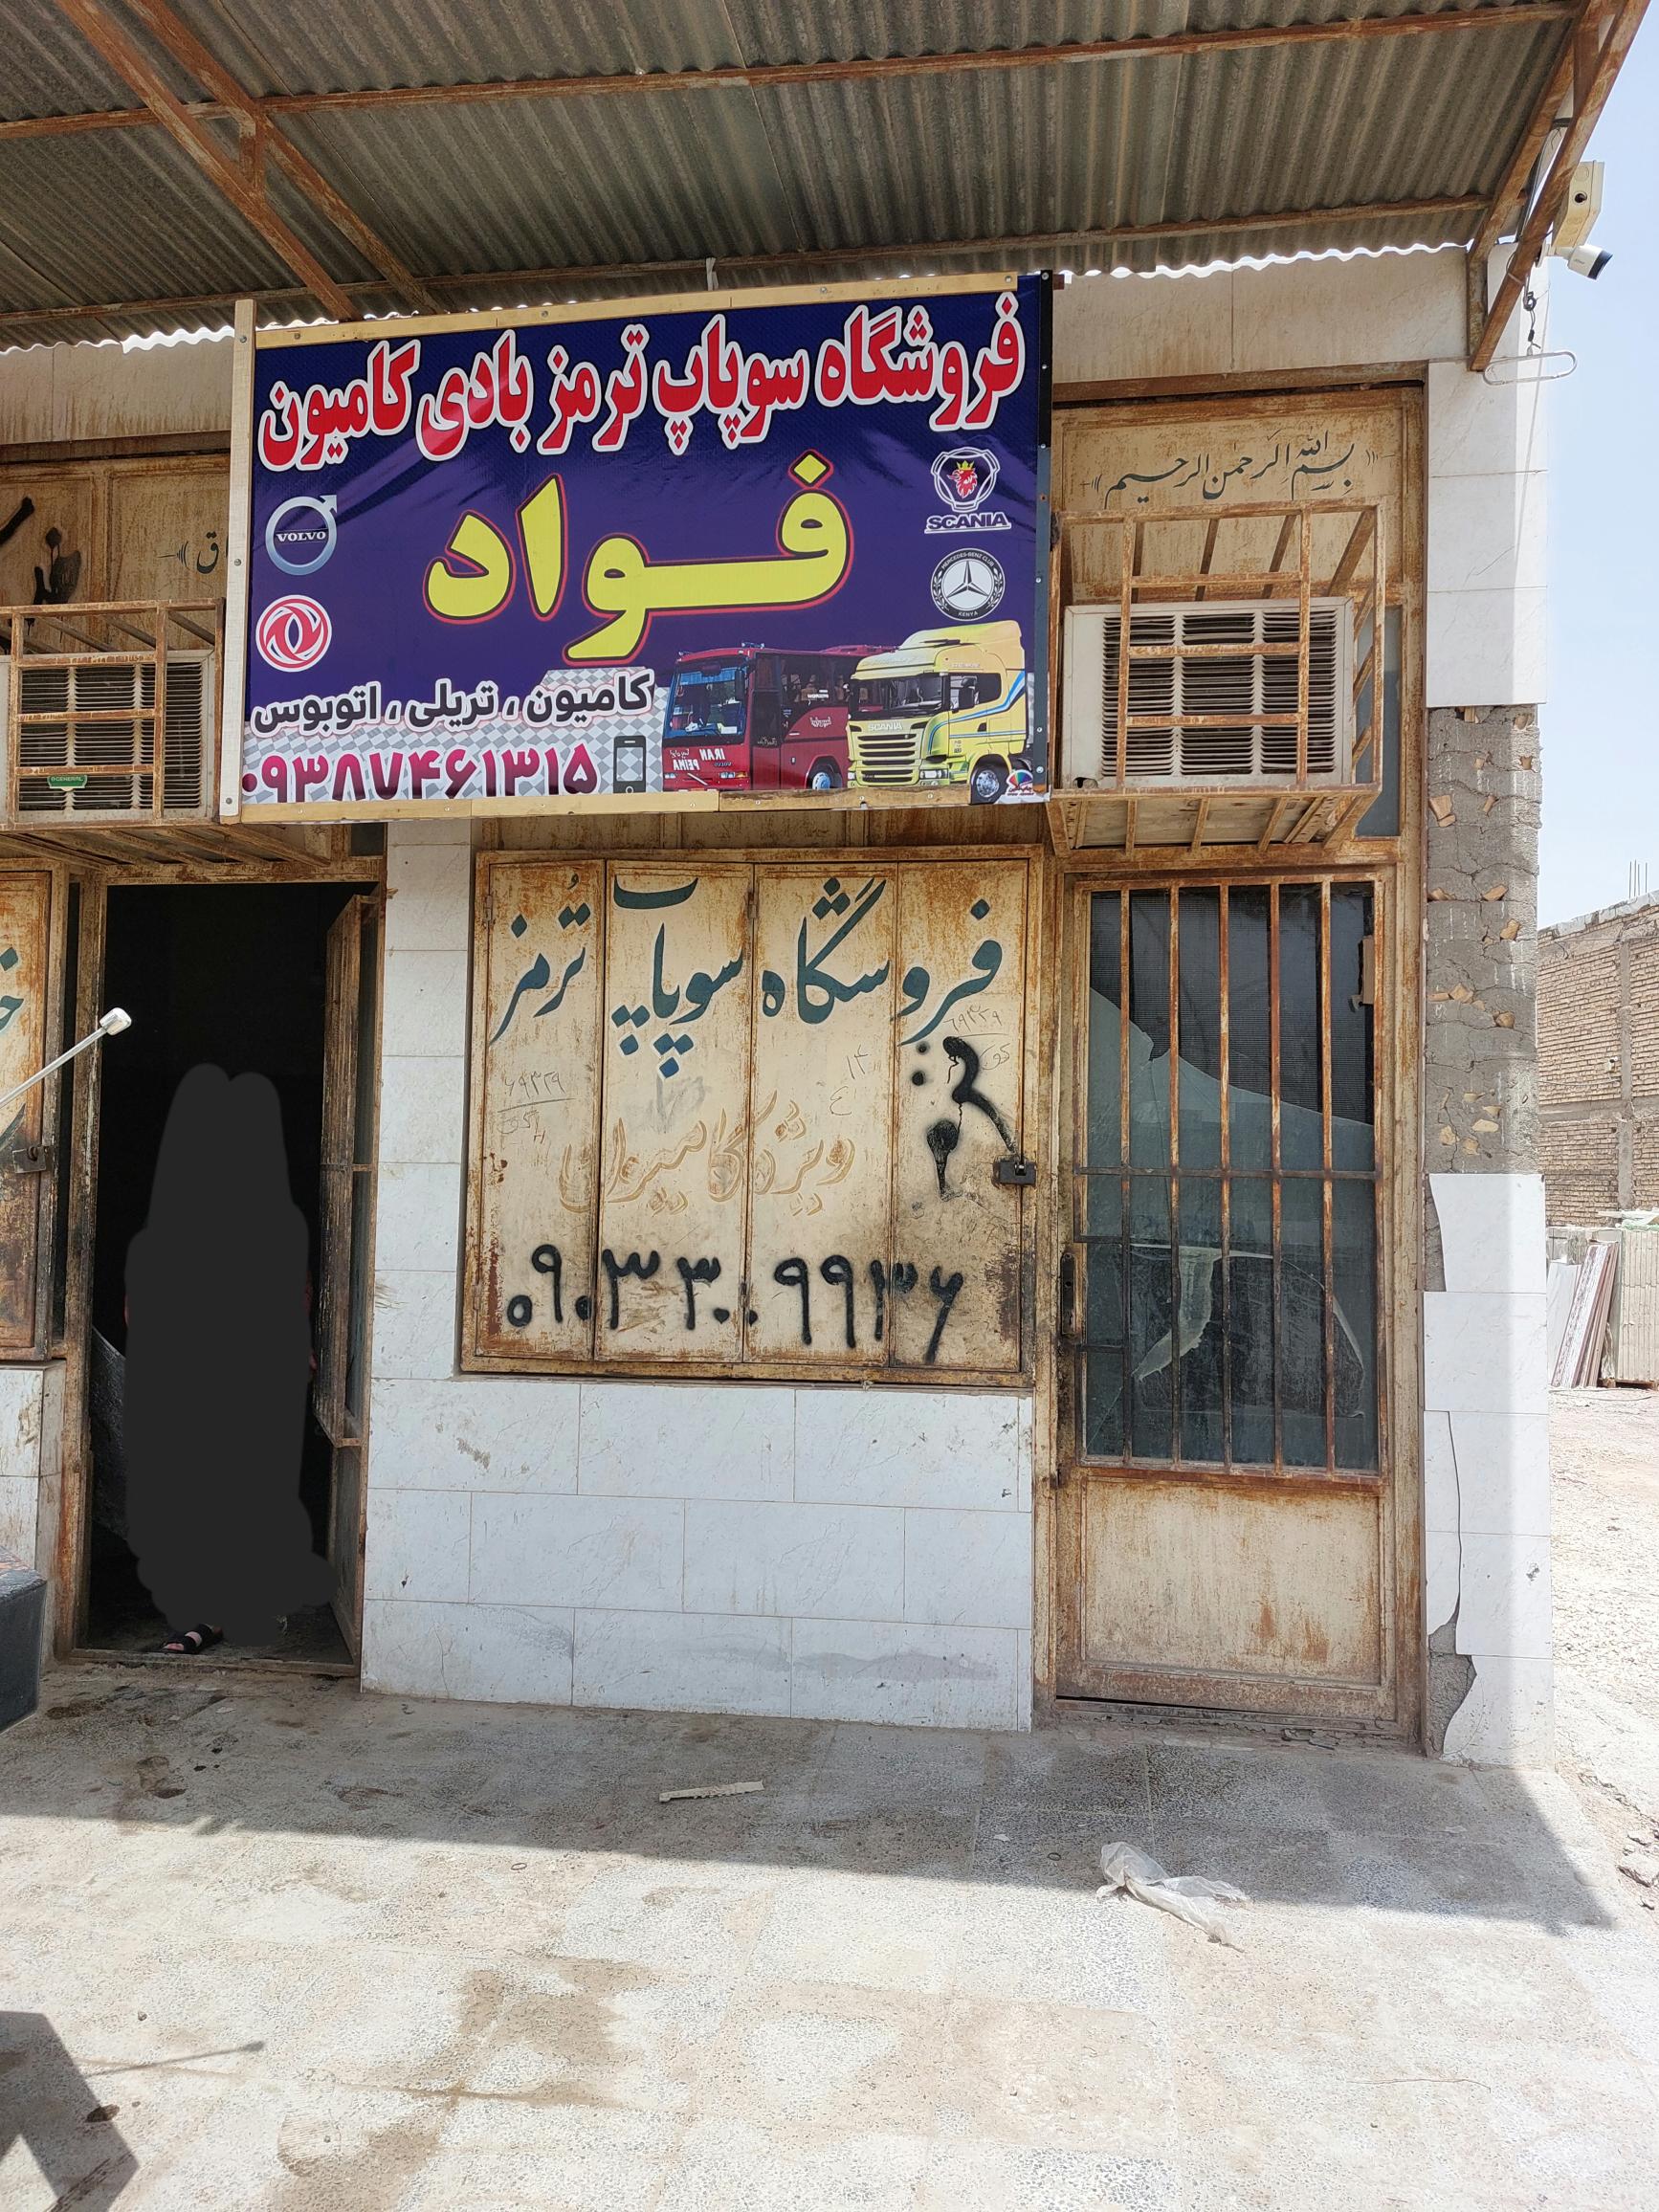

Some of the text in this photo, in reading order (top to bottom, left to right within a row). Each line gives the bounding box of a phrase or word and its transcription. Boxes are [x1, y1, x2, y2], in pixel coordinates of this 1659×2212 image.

[258, 291, 1027, 471] فروشگاه سوپاپ ترمز بادی کامیون
[276, 531, 326, 542] VOLVO
[926, 512, 1010, 532] SCANIA
[423, 449, 855, 666] فواد
[958, 609, 979, 618] KENYA
[254, 682, 381, 738] اتوبوس
[409, 678, 498, 729] تریلی
[526, 669, 654, 728] کامیون
[761, 875, 1006, 1048] فروشگاه
